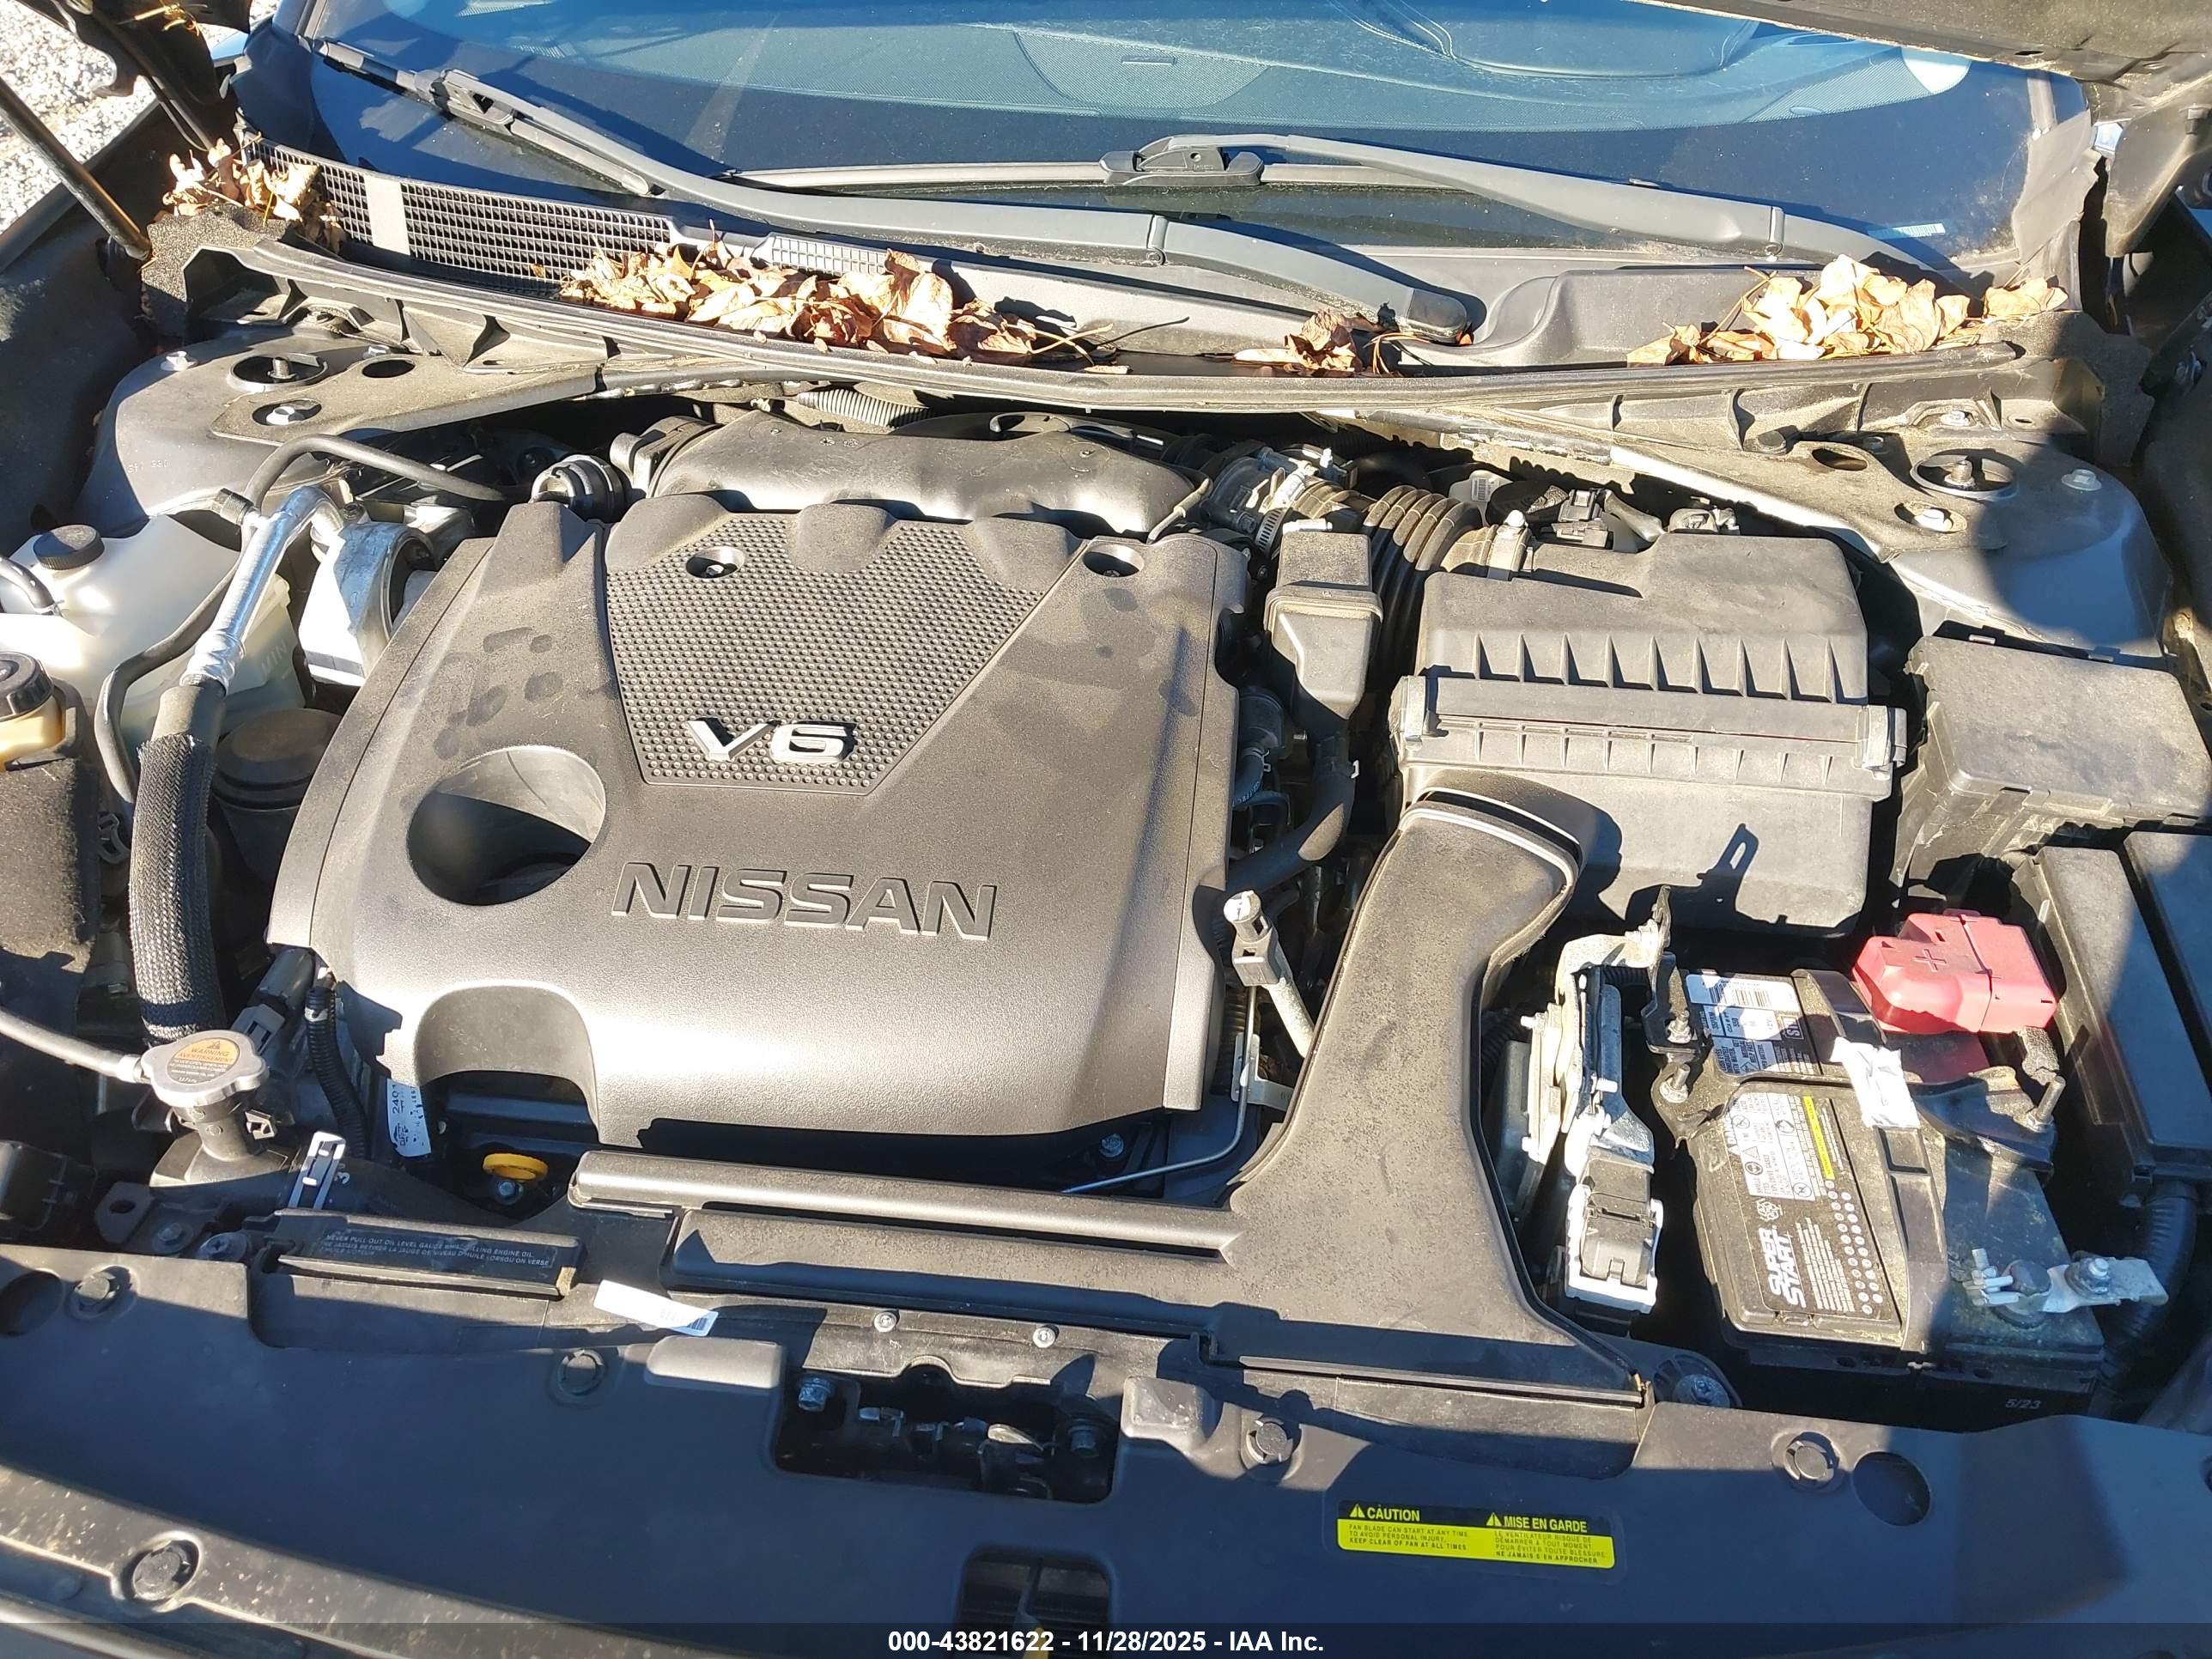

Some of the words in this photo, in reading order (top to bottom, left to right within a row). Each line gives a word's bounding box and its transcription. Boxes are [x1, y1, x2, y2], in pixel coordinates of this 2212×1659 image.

[687, 719, 849, 763] V6
[611, 861, 997, 941] NISSAN
[191, 1048, 230, 1057] WARNING
[1759, 1228, 1782, 1295] SUPER
[1772, 1228, 1807, 1309] START
[2006, 1398, 2041, 1409] 5/23
[1367, 1507, 1420, 1522] CAUTION
[1504, 1516, 1530, 1528] MISE
[1532, 1517, 1547, 1529] EN
[1549, 1518, 1588, 1533] GARDE
